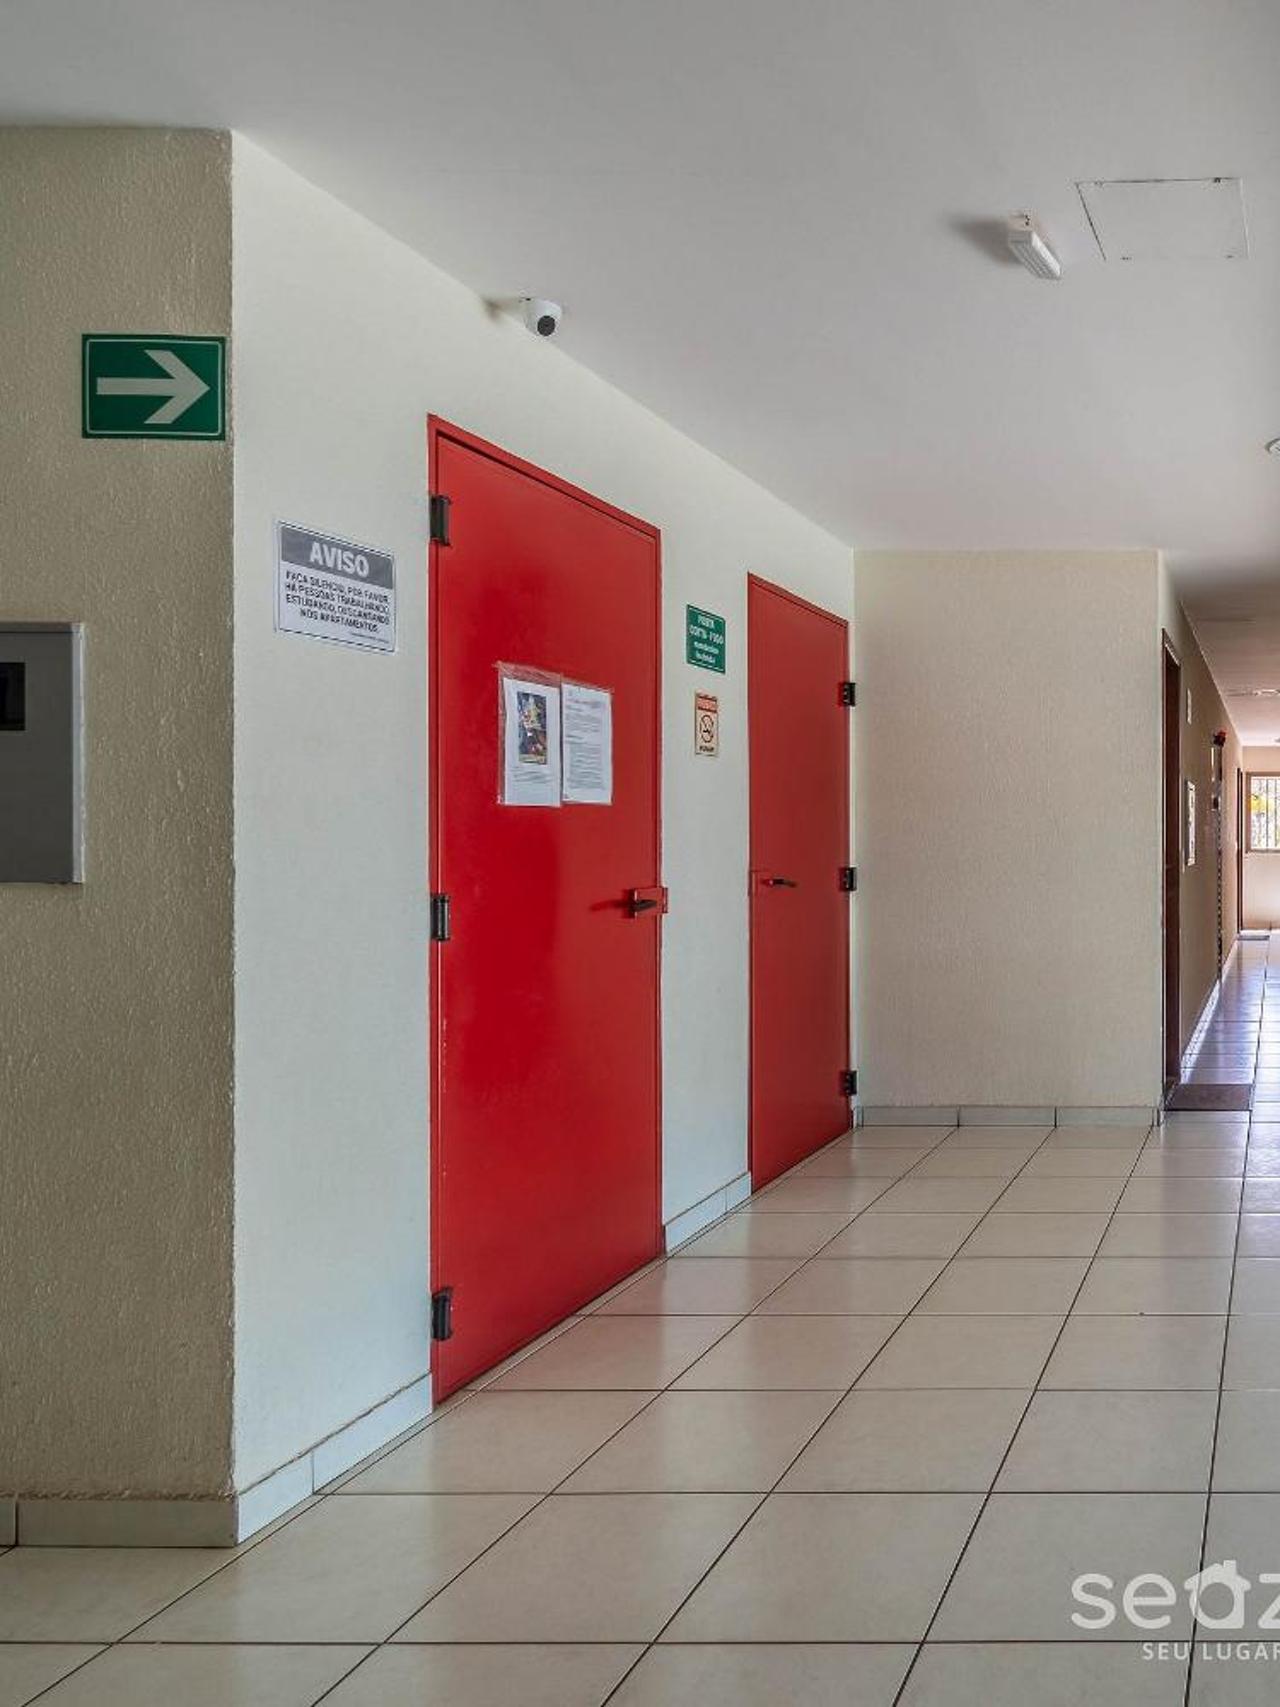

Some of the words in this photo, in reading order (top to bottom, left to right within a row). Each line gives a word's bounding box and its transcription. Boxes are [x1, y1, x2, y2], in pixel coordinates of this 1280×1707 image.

[310, 541, 370, 578] AVISO
[299, 584, 336, 601] PESSOAS
[301, 609, 318, 620] NOS
